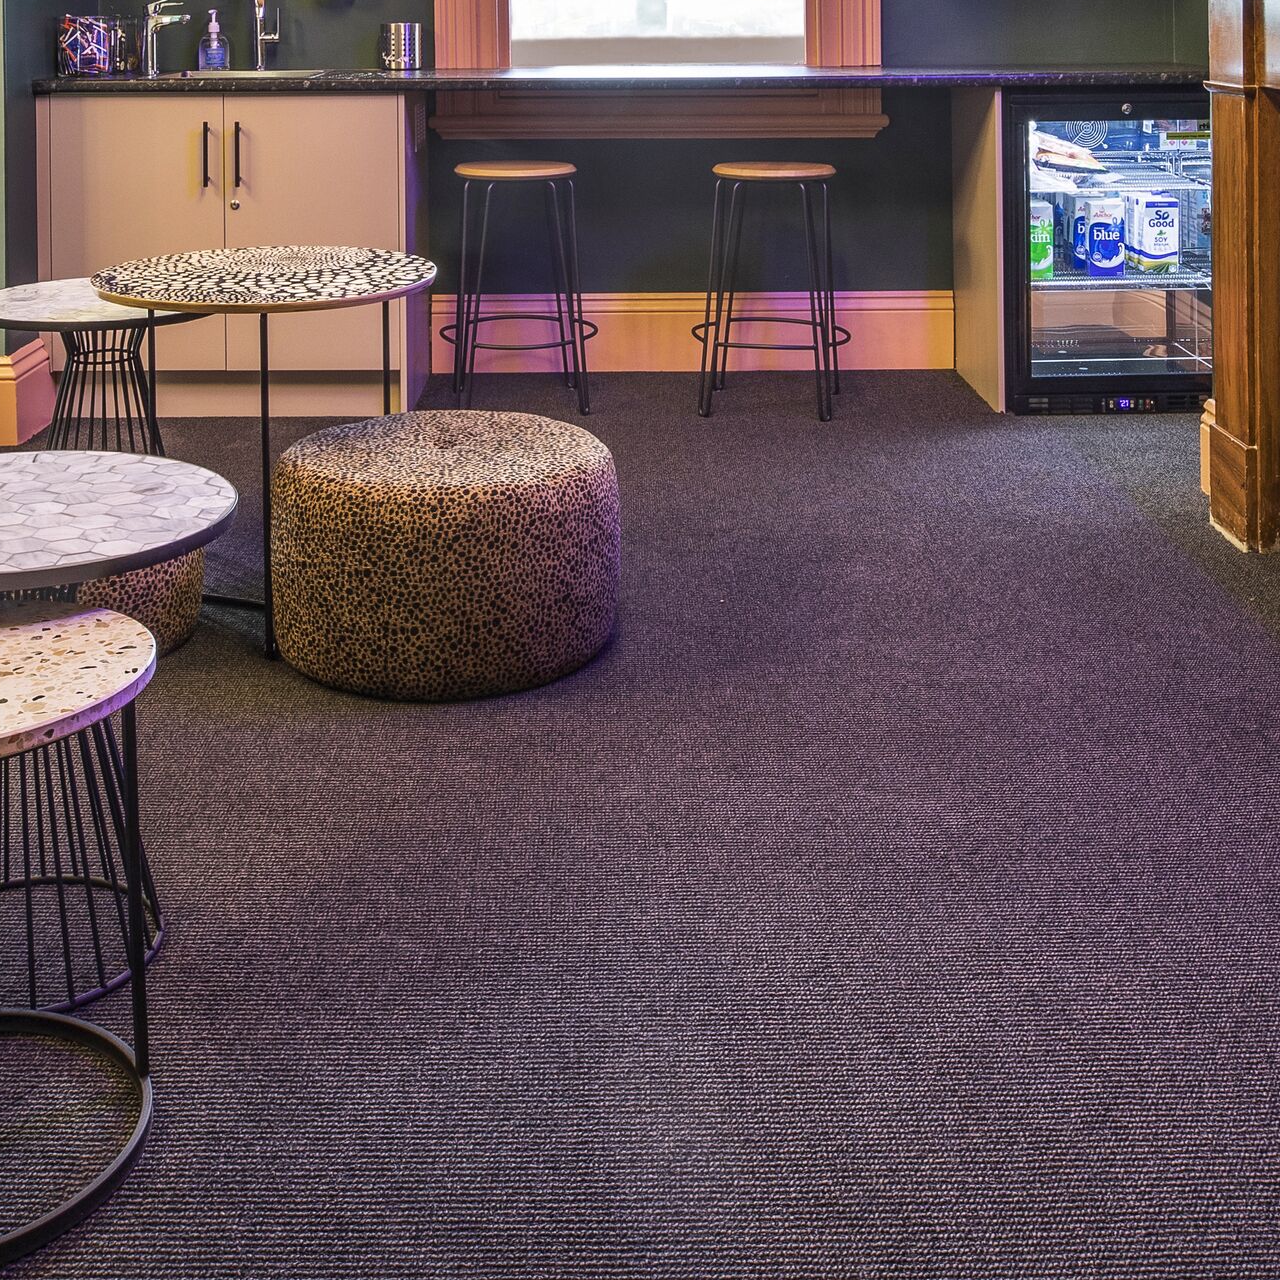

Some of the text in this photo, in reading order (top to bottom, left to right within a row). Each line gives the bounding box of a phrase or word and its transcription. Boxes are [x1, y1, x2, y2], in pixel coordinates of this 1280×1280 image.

[1155, 209, 1169, 220] So
[1148, 218, 1174, 228] Good
[1093, 229, 1120, 240] blue
